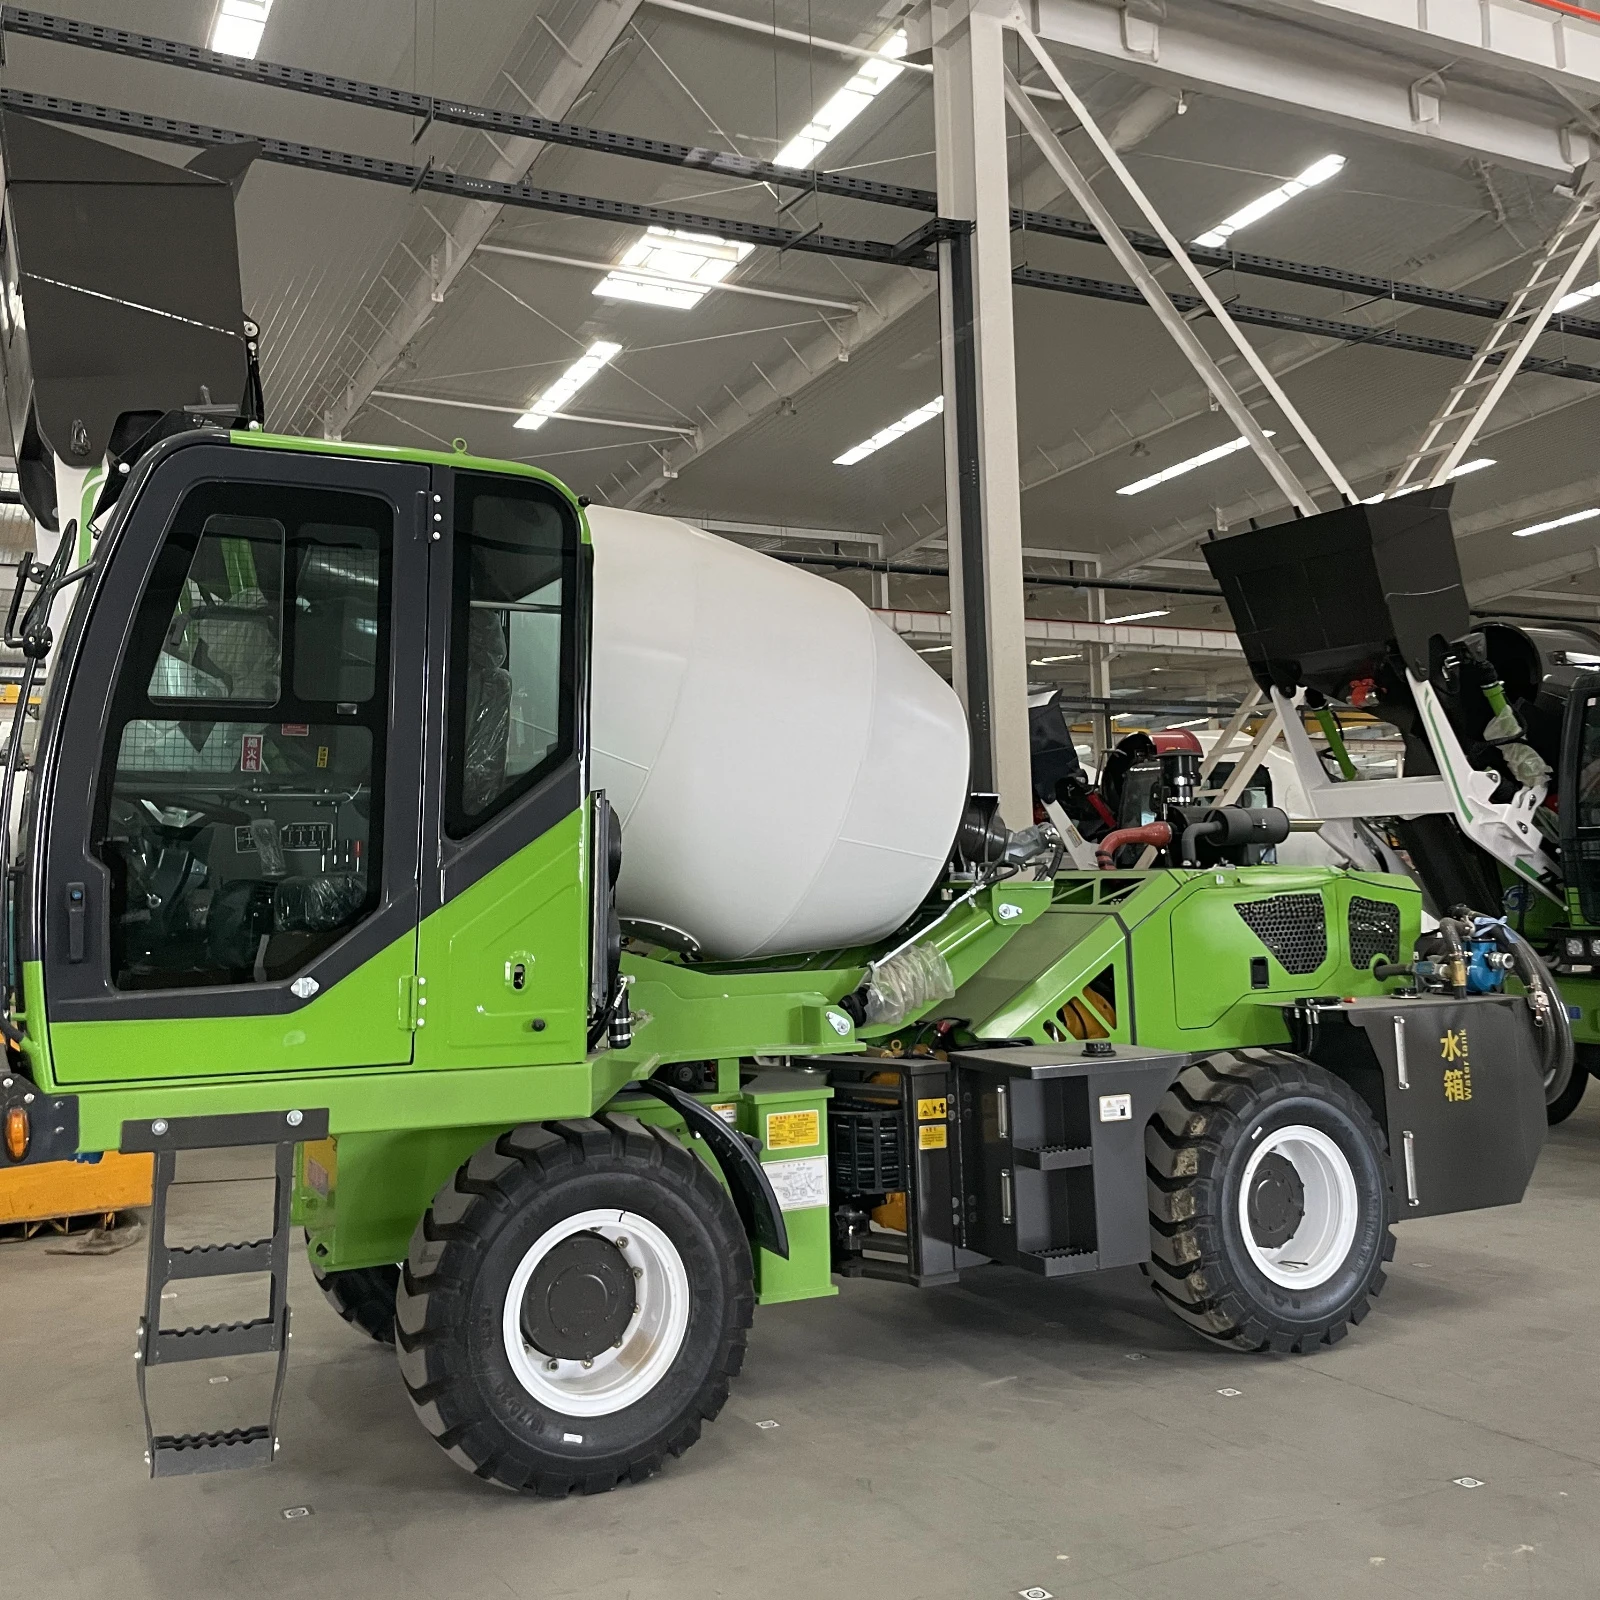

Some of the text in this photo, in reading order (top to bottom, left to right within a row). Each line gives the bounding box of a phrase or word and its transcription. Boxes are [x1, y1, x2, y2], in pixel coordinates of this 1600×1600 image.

[1440, 1029, 1464, 1102] 水箱
[1459, 1029, 1472, 1100] Water tank
